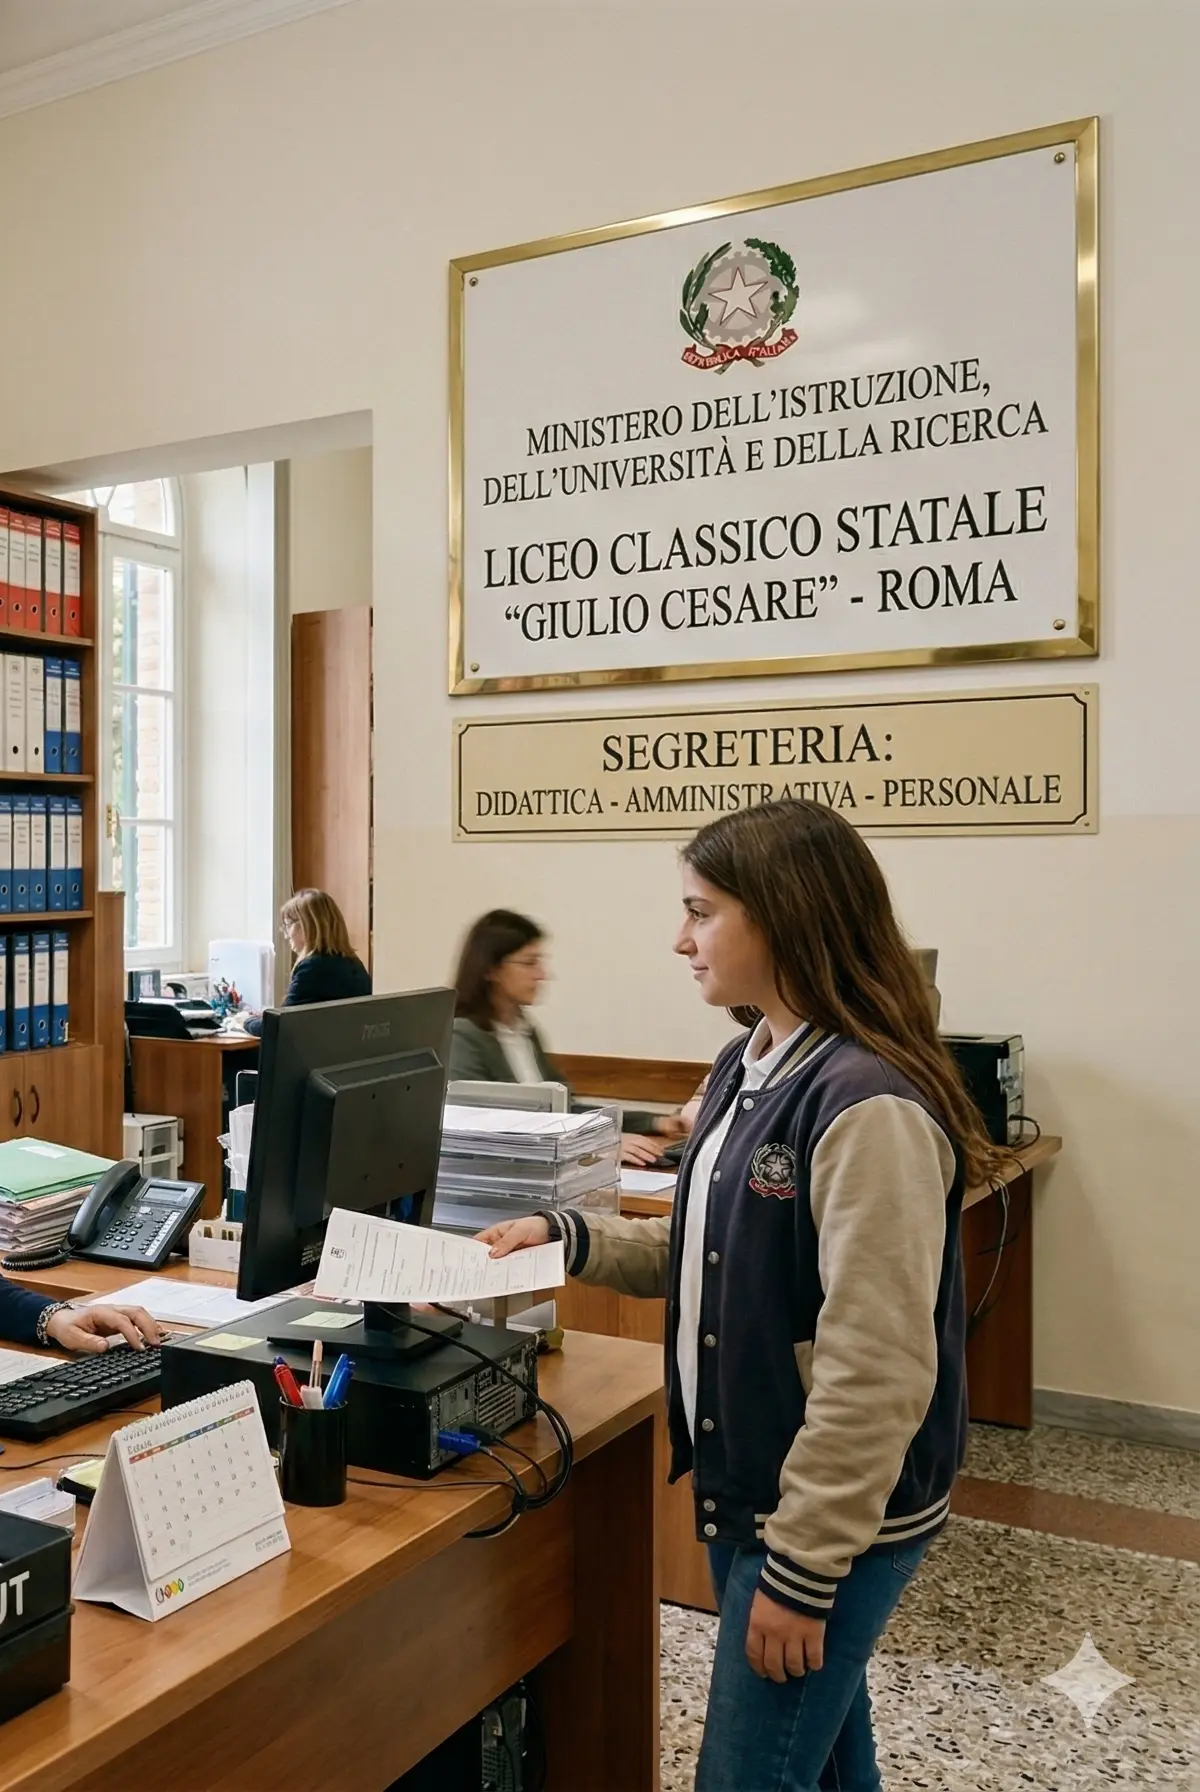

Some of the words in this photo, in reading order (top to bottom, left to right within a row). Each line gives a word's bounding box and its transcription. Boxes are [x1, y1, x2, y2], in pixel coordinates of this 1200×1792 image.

[483, 435, 737, 506] DELL’UNIVERSITÀ
[745, 439, 764, 472] E
[773, 423, 883, 469] DELLA
[890, 400, 1049, 453] RICERCA
[526, 404, 683, 457] MINISTERO
[691, 358, 991, 433] DELL’ISTRUZIONE,
[483, 537, 599, 589] LICEO
[610, 512, 822, 576] CLASSICO
[836, 485, 1048, 554] STATALE
[504, 593, 650, 642] “GIULIO
[660, 574, 838, 630] CESARE”
[850, 596, 864, 604] -
[877, 558, 1019, 613] ROMA
[602, 723, 893, 772] SEGRETERIA:
[475, 787, 604, 817] DIDATTICA
[882, 774, 1063, 808] PERSONALE
